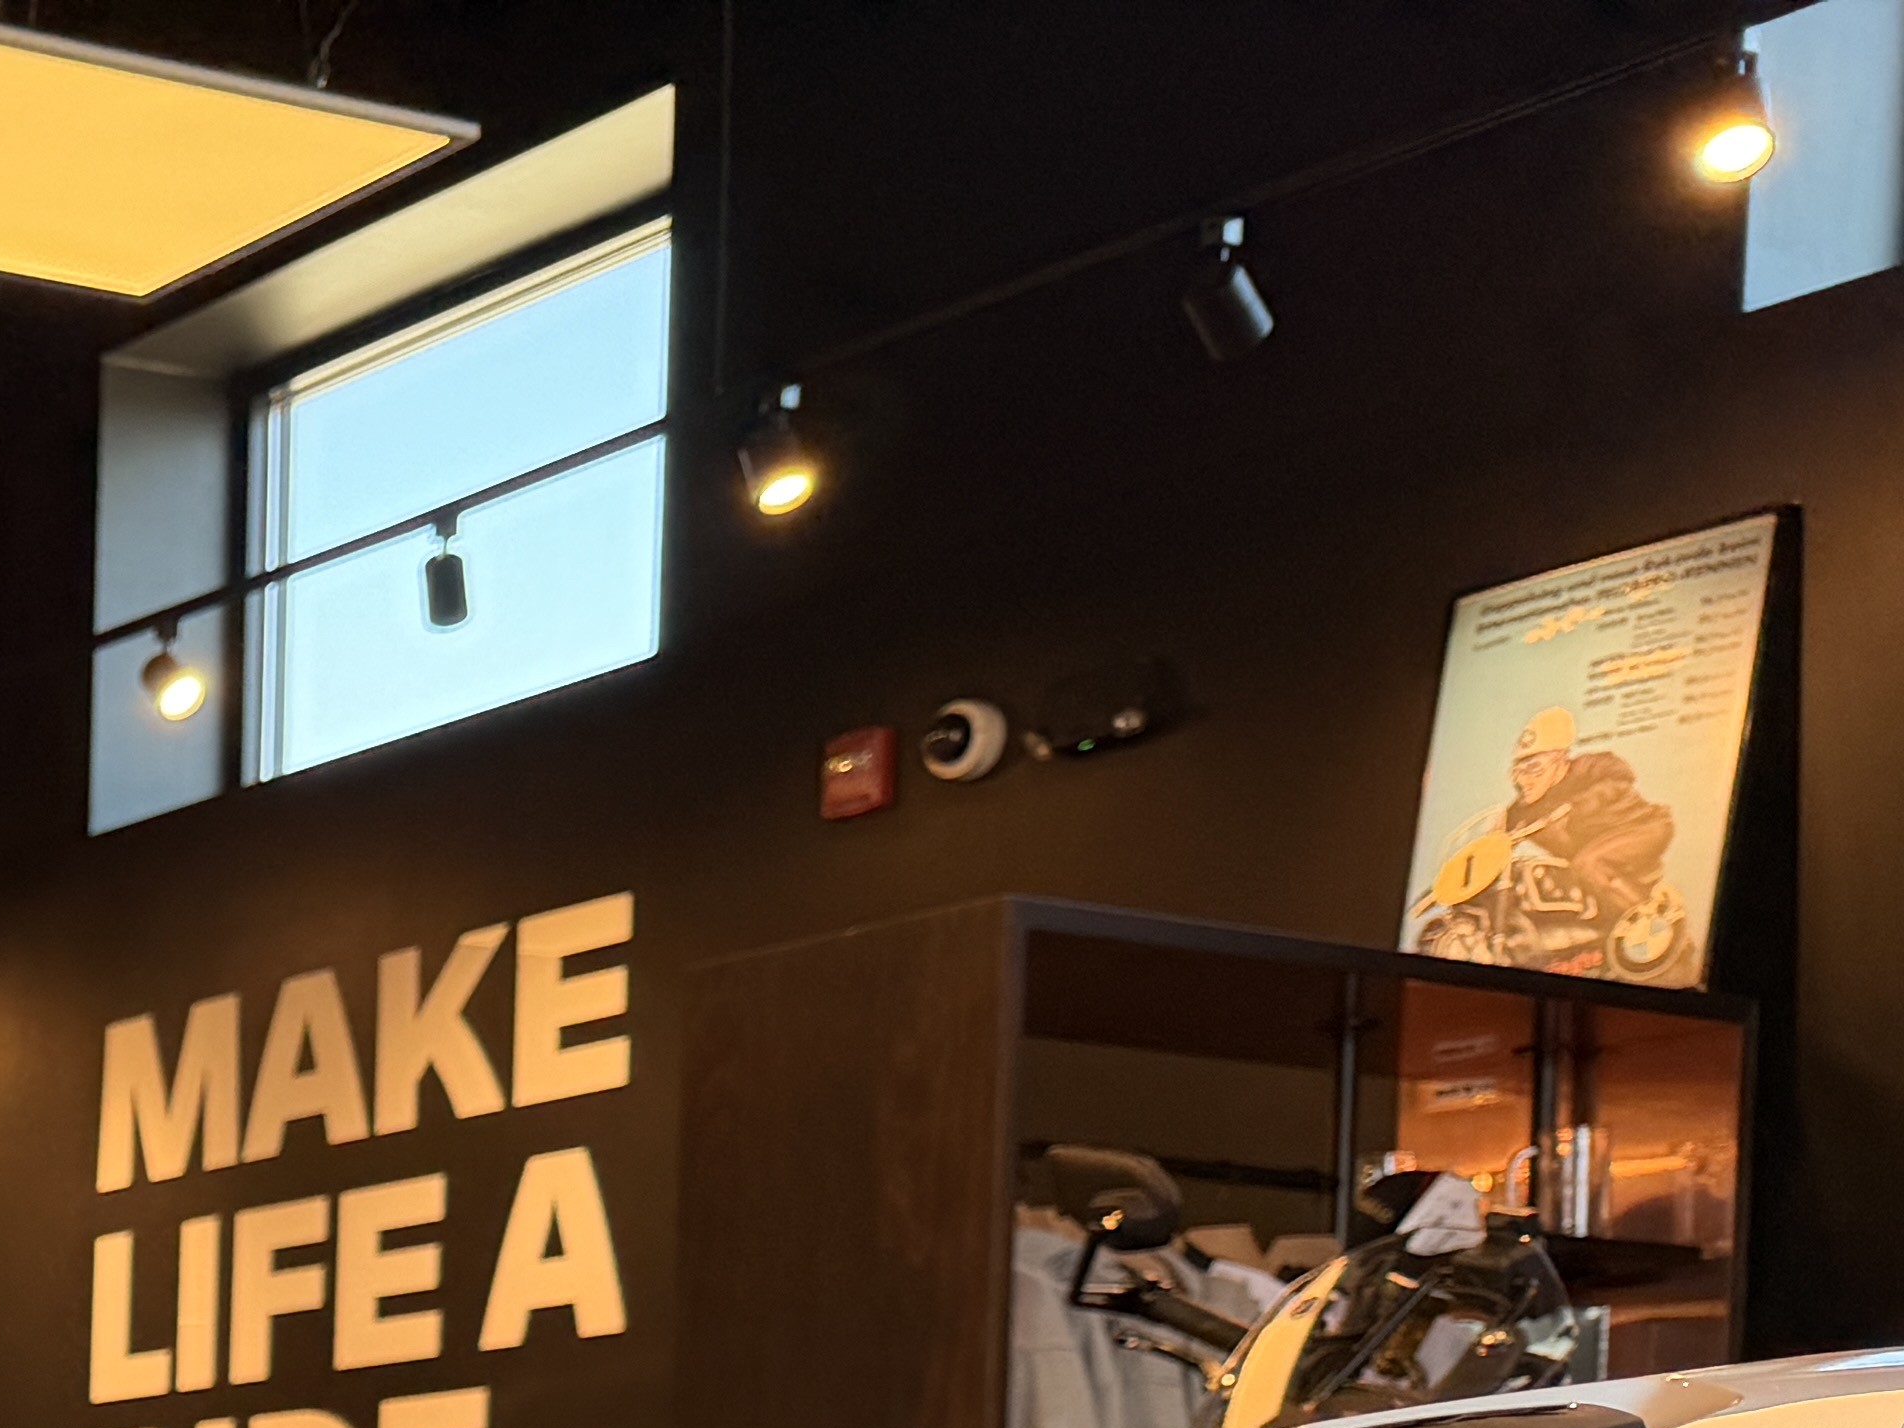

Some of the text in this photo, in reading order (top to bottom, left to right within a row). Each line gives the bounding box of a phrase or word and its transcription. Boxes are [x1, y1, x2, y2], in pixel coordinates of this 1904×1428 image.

[95, 889, 636, 1194] MAKE
[88, 1146, 628, 1405] LIFE A
